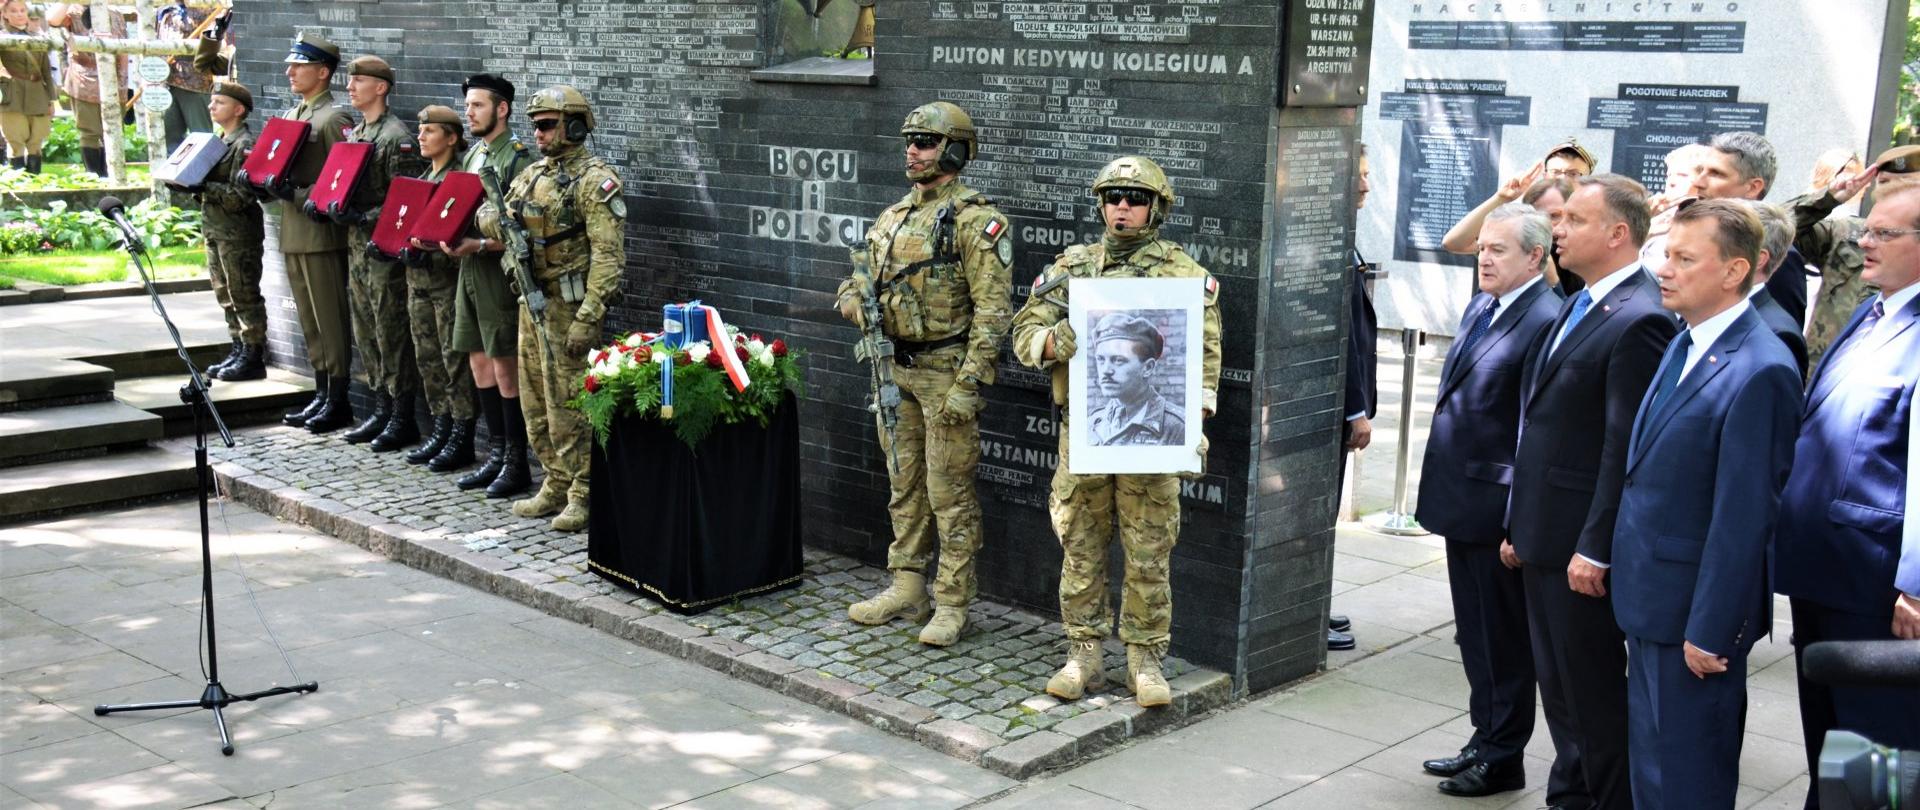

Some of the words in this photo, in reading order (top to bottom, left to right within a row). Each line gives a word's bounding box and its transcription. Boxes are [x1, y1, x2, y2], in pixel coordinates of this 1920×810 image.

[1005, 4, 1034, 12] ROMAN
[1040, 5, 1084, 13] PADLEWSKI
[1099, 6, 1112, 14] NN
[1135, 6, 1148, 15] NN
[1184, 7, 1197, 15] NN
[318, 8, 356, 22] WAWER
[1015, 23, 1048, 31] TADEUSZ
[1054, 24, 1098, 33] SZYPULSKI
[1103, 25, 1119, 33] JAN
[1124, 26, 1185, 35] WOLANOWSKI
[1311, 30, 1353, 41] WARSZAWA
[932, 46, 1005, 65] PLUTON
[1013, 48, 1104, 69] KEDYWU
[1113, 52, 1227, 74] KOLEGIUM
[1237, 56, 1253, 75] A
[1308, 61, 1352, 73] ARGENTYNA
[984, 76, 998, 85] JAN
[1002, 77, 1045, 87] ADAMCZYK
[940, 91, 991, 100] WŁODZIMIERZ
[1626, 87, 1678, 97] POGOTOWIE
[1679, 89, 1728, 98] HARCEREK
[1069, 98, 1084, 106] JAN
[1050, 114, 1074, 123] ADAM
[1078, 116, 1102, 125] KAFEL
[1110, 118, 1146, 127] WACŁAW
[1151, 120, 1218, 132] KORZENIOWSKI
[983, 127, 1020, 137] MATYSIAK
[1028, 130, 1064, 140] BARBARA
[1068, 134, 1115, 144] NIKLEWSKA
[1123, 137, 1156, 147] WITOLD
[1159, 139, 1205, 150] PIEKARSKI
[1646, 134, 1699, 145] CHORĄGWIE
[977, 144, 1015, 154] AZIMIERZ
[773, 149, 855, 181] BOGU
[1204, 218, 1219, 228] NN
[1022, 225, 1075, 246] GRUP
[1026, 415, 1057, 437] ZGI
[980, 439, 1059, 471] WSTANIU
[1182, 479, 1223, 504] KIM
